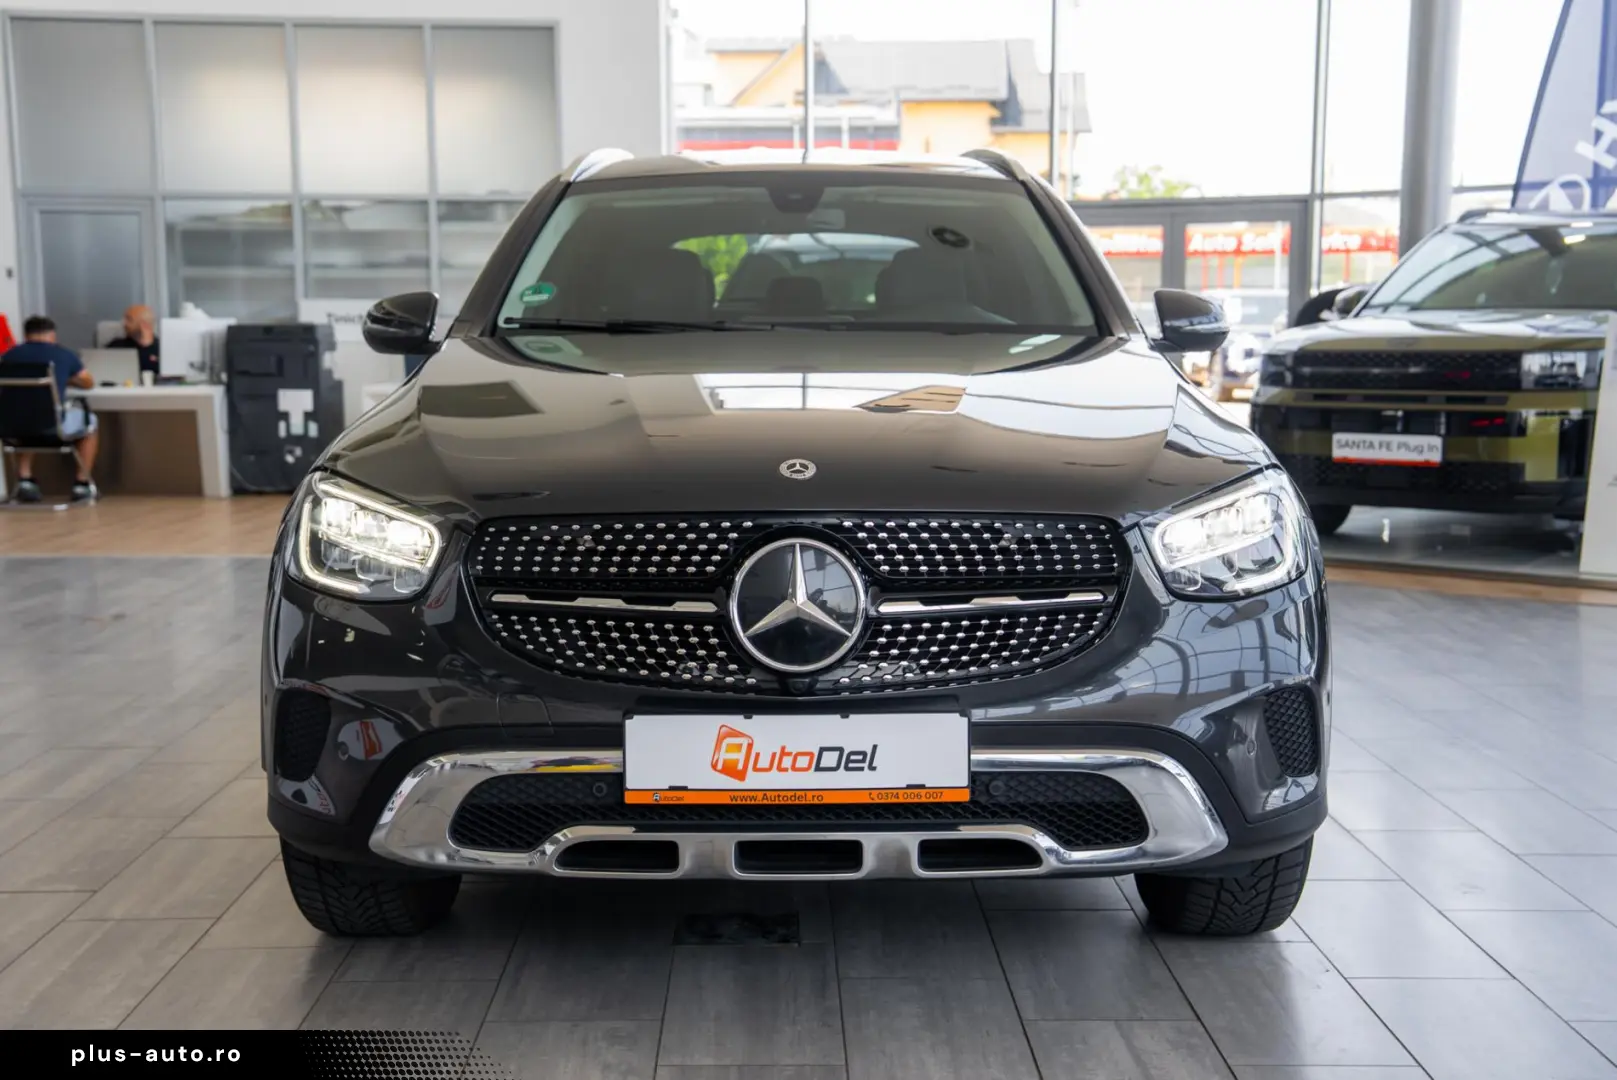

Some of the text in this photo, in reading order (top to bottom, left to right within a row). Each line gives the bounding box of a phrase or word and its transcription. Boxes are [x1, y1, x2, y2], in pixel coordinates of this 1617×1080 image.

[1335, 438, 1439, 455] SANTA FE Plug In
[712, 732, 878, 775] AutoDel
[729, 792, 824, 803] www.Autodel.ro
[876, 791, 943, 801] 0374 006 007
